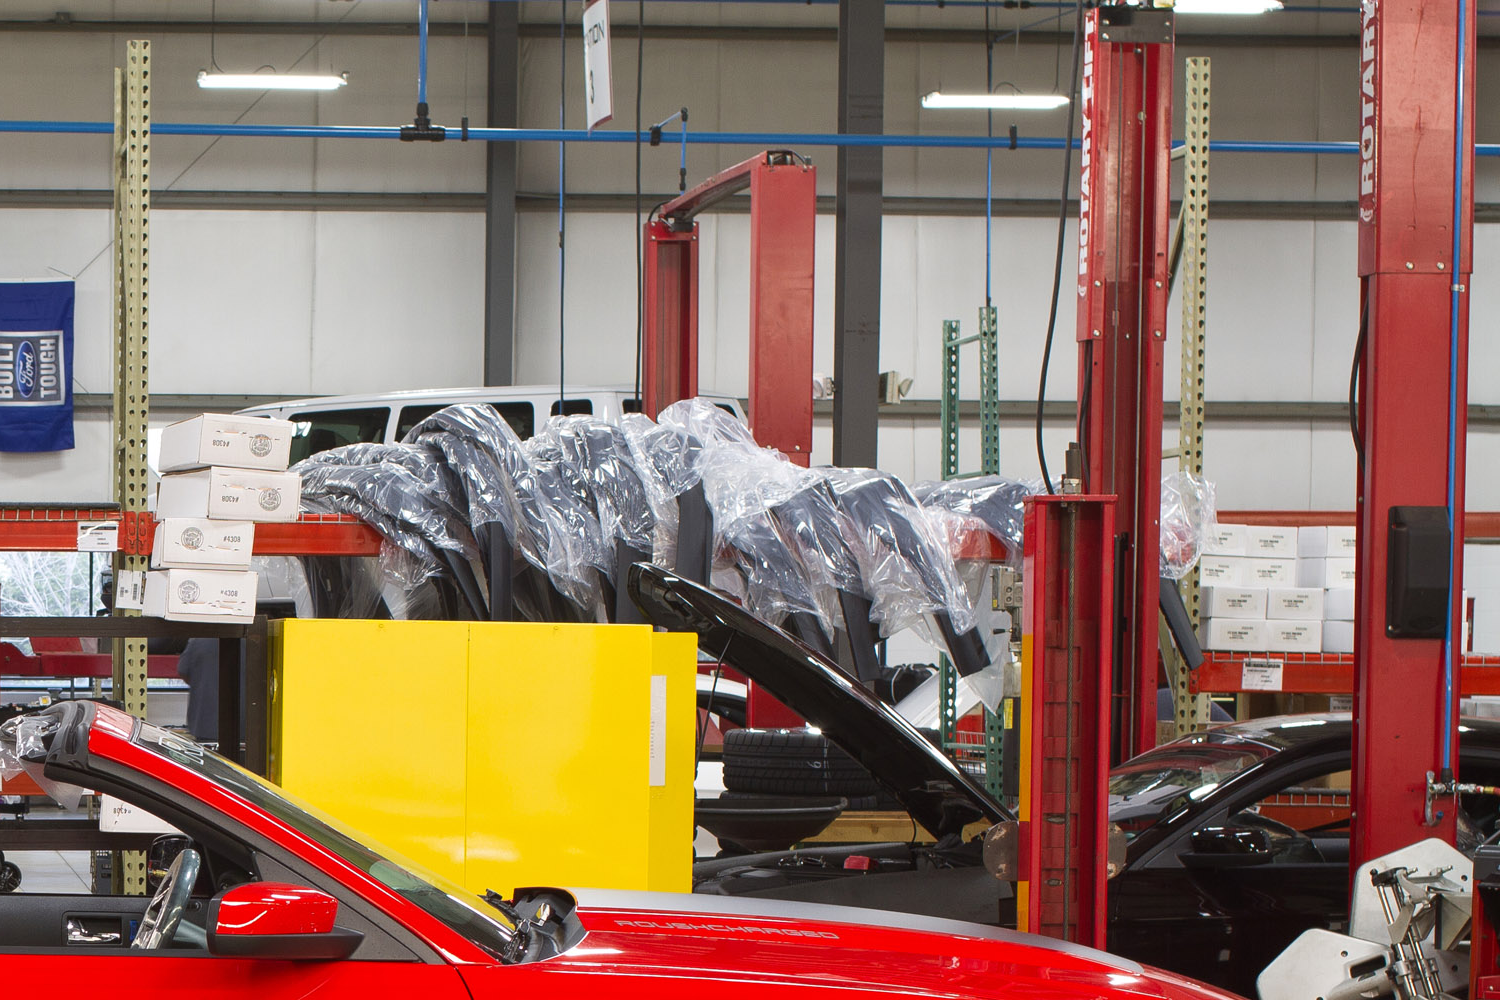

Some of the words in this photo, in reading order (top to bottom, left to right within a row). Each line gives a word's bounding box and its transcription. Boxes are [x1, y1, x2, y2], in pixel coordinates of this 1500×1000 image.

[1082, 16, 1095, 105] LIFT
[1079, 112, 1092, 275] ROTARY
[19, 351, 34, 388] Ford
[39, 338, 57, 399] TOUGH
[221, 495, 240, 503] #4308
[223, 535, 241, 543] #4308
[220, 589, 239, 598] #4308
[614, 918, 840, 940] ROUSHCHARGED
